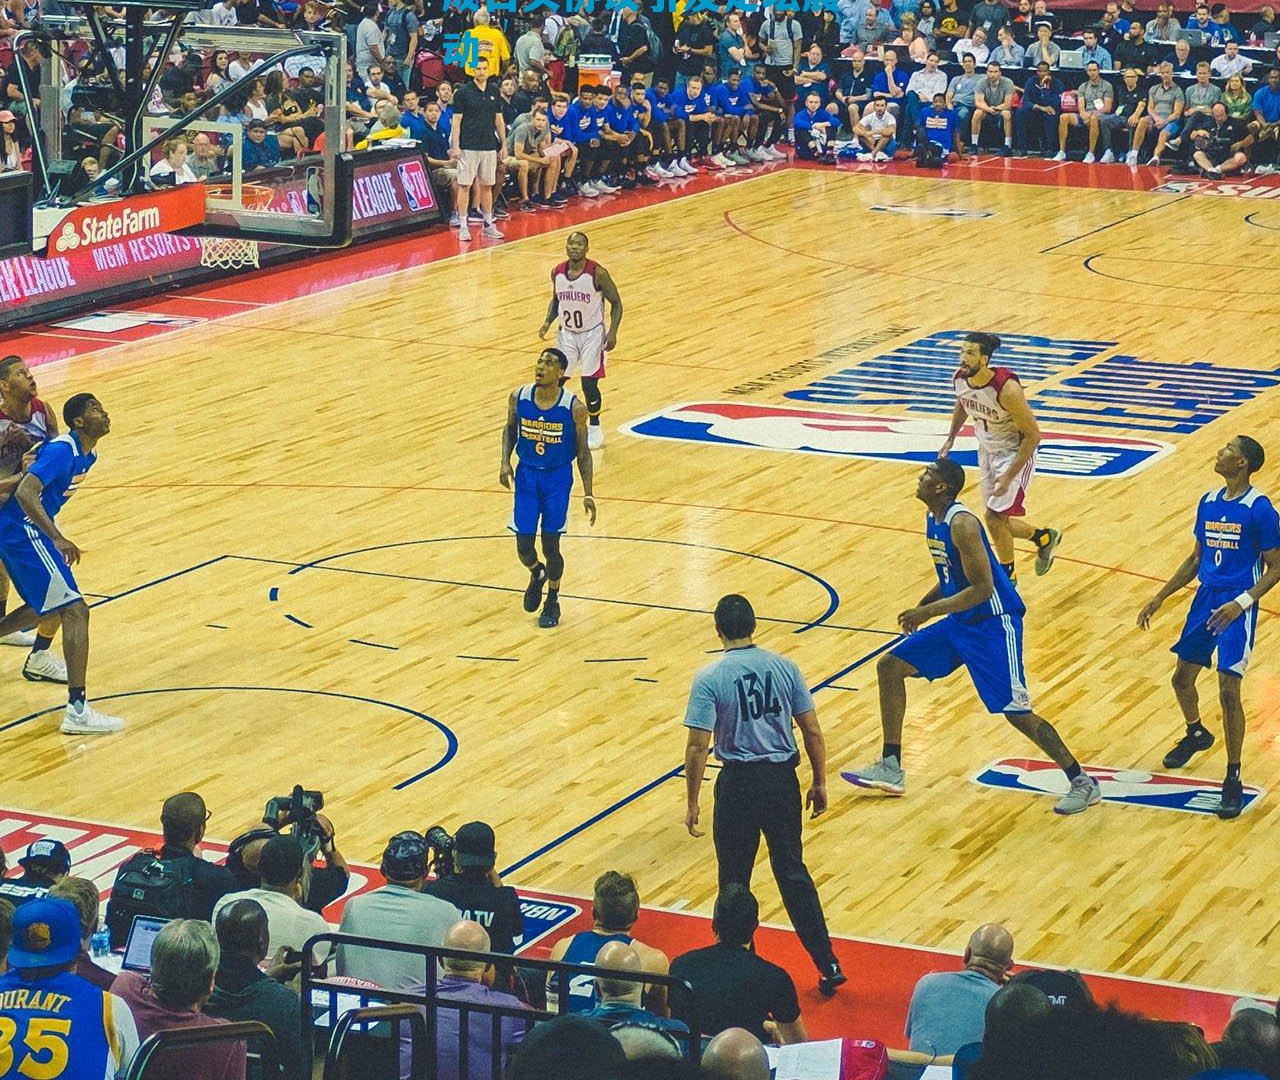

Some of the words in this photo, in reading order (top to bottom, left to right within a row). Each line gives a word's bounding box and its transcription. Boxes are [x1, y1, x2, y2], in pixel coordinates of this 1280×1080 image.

[358, 172, 402, 219] LEAGUE
[412, 172, 428, 199] TV
[81, 213, 121, 246] State
[122, 206, 160, 236] Farm
[15, 256, 76, 297] LEAGUE
[92, 243, 128, 271] MGM
[128, 233, 191, 263] RESORTS
[564, 310, 583, 329] 20
[521, 417, 563, 431] WARRIORS
[535, 442, 545, 456] 6
[1215, 549, 1222, 566] 0
[734, 671, 782, 722] 134
[474, 911, 494, 928] TV
